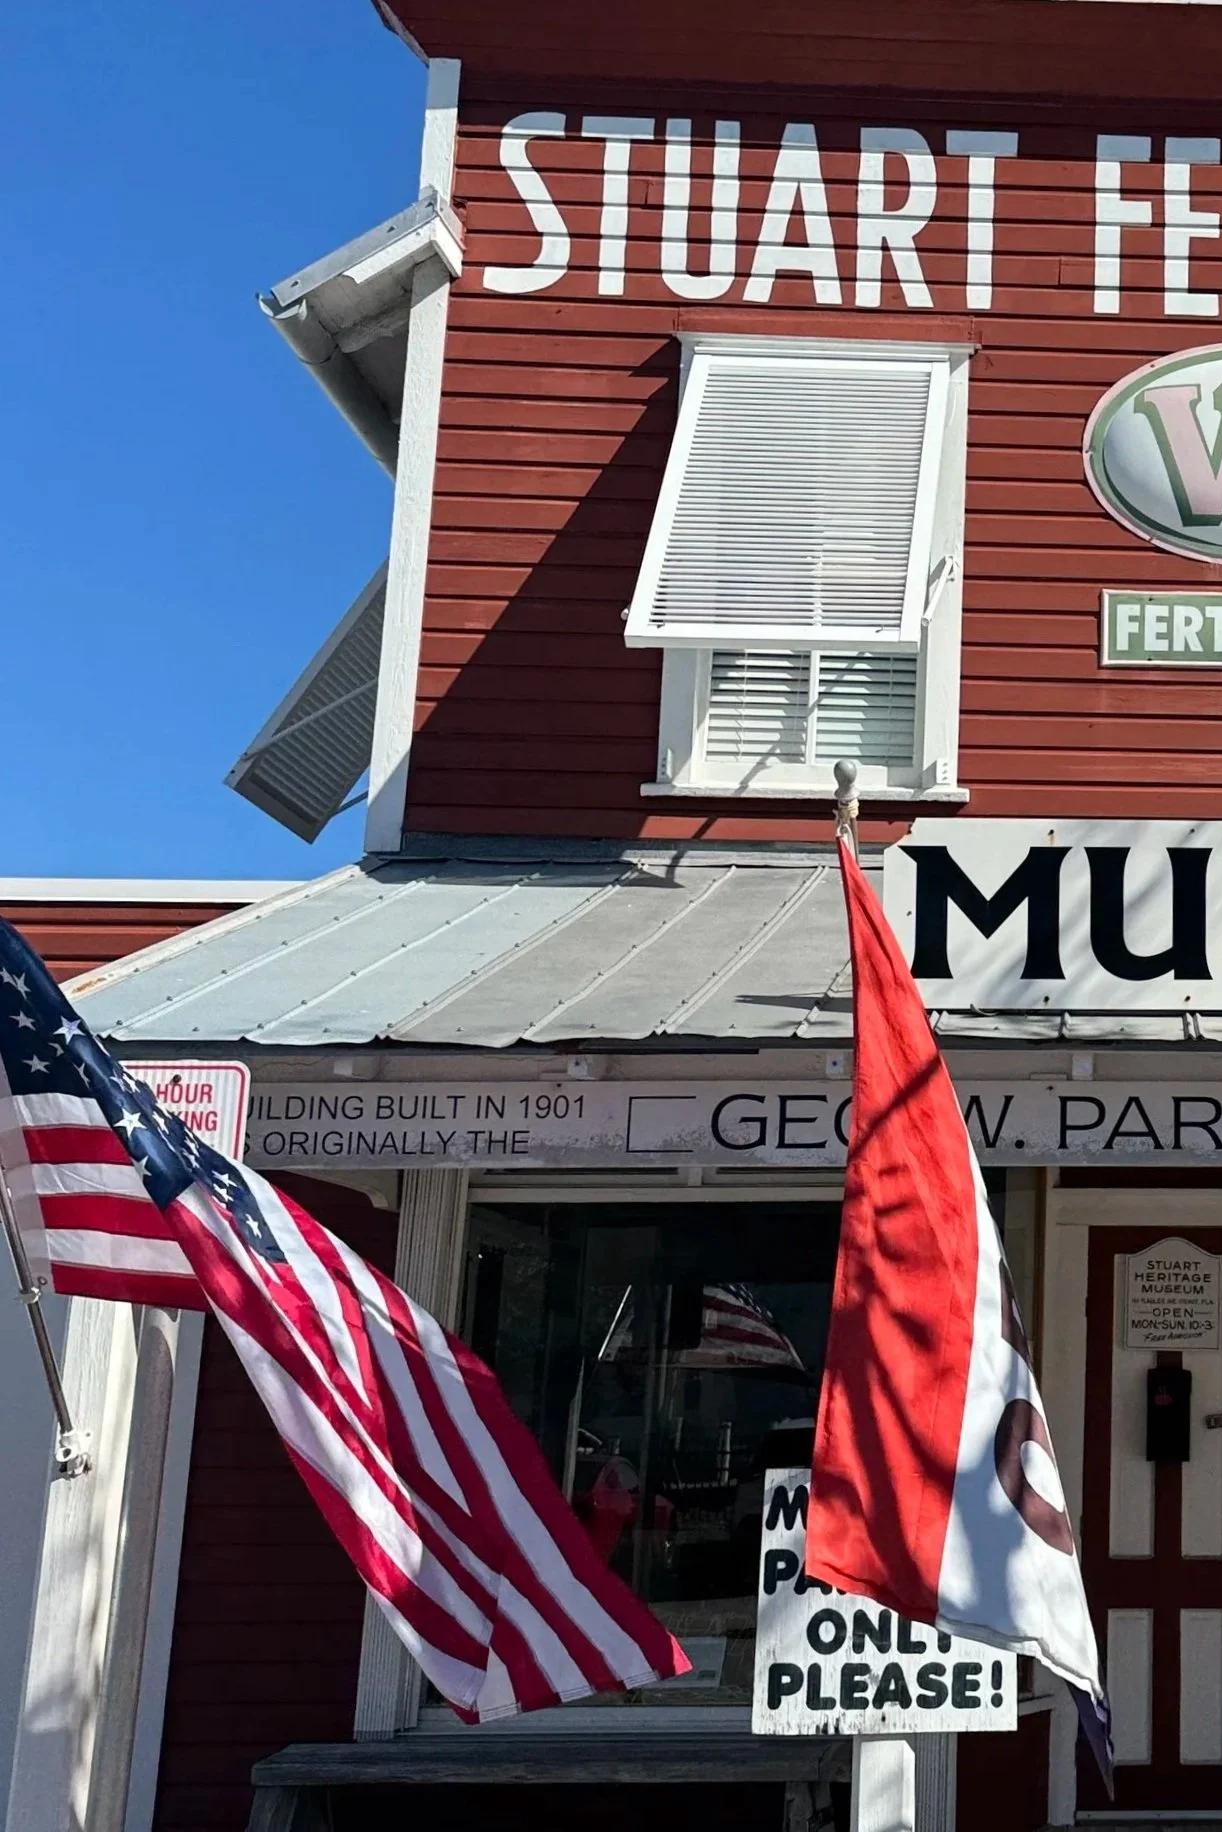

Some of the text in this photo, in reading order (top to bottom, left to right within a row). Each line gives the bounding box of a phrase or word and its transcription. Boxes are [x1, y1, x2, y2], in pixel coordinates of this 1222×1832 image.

[482, 112, 1018, 310] STUART
[156, 1083, 213, 1104] HOUR
[249, 1095, 585, 1121] ILDING BUILT IN 1901
[263, 1131, 457, 1156] ORIGINALLY
[463, 1130, 530, 1155] THE
[1147, 1260, 1201, 1271] STUART
[1134, 1272, 1212, 1283] HERITAGE
[1141, 1284, 1204, 1295] MUSEUM
[1152, 1308, 1194, 1318] OPEN
[766, 1659, 1004, 1711] PLEASE!
